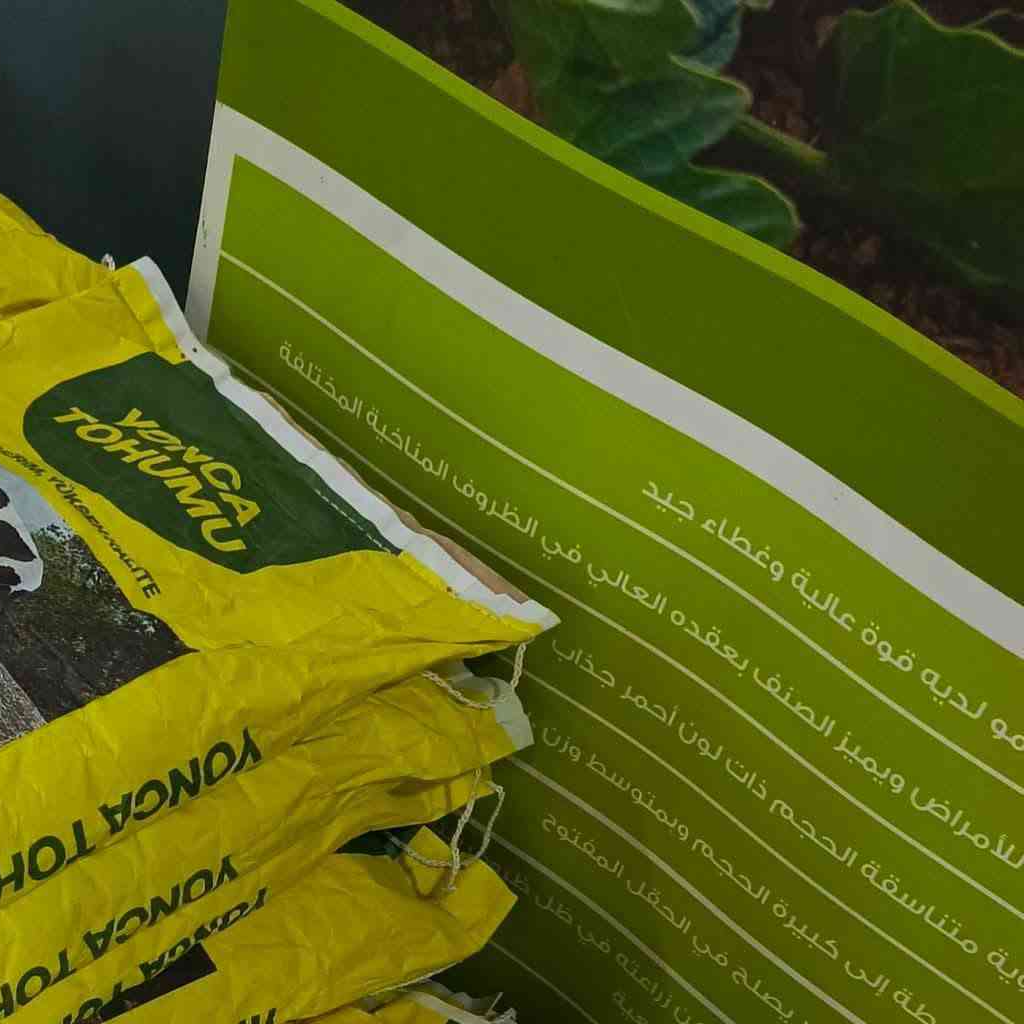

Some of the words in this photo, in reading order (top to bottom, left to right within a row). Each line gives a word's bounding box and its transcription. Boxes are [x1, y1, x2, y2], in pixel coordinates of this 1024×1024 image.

[279, 340, 363, 418] المختلفة
[114, 407, 262, 527] YONCA
[366, 407, 449, 481] المناخية
[52, 406, 247, 552] TOHUMU
[452, 473, 538, 538] الظروف
[642, 480, 695, 522] جيد
[541, 535, 582, 563] في
[701, 518, 784, 581] وغطاء
[587, 562, 667, 615] العالي
[791, 568, 856, 631] عالية
[552, 639, 616, 689] جذاب
[670, 610, 749, 676] بعقده
[861, 621, 916, 672] قوة
[619, 684, 678, 727] أحمر
[753, 667, 835, 737] الصنف
[920, 667, 988, 720] لديه
[542, 726, 582, 762] وزن
[679, 720, 725, 761] لون
[833, 731, 906, 793] ويميز
[99, 727, 263, 836] YONCA
[726, 758, 767, 801] ذات
[542, 814, 625, 879] المفتوح
[769, 798, 858, 867] الحجم
[692, 839, 771, 905] الحجم
[82, 855, 239, 961] YONCA
[626, 879, 692, 934] الحقل
[772, 900, 839, 961] كبيرة
[860, 859, 978, 954] متناسقة
[692, 935, 729, 967] في
[844, 961, 891, 996] إلى
[732, 966, 795, 1024] يصلح
